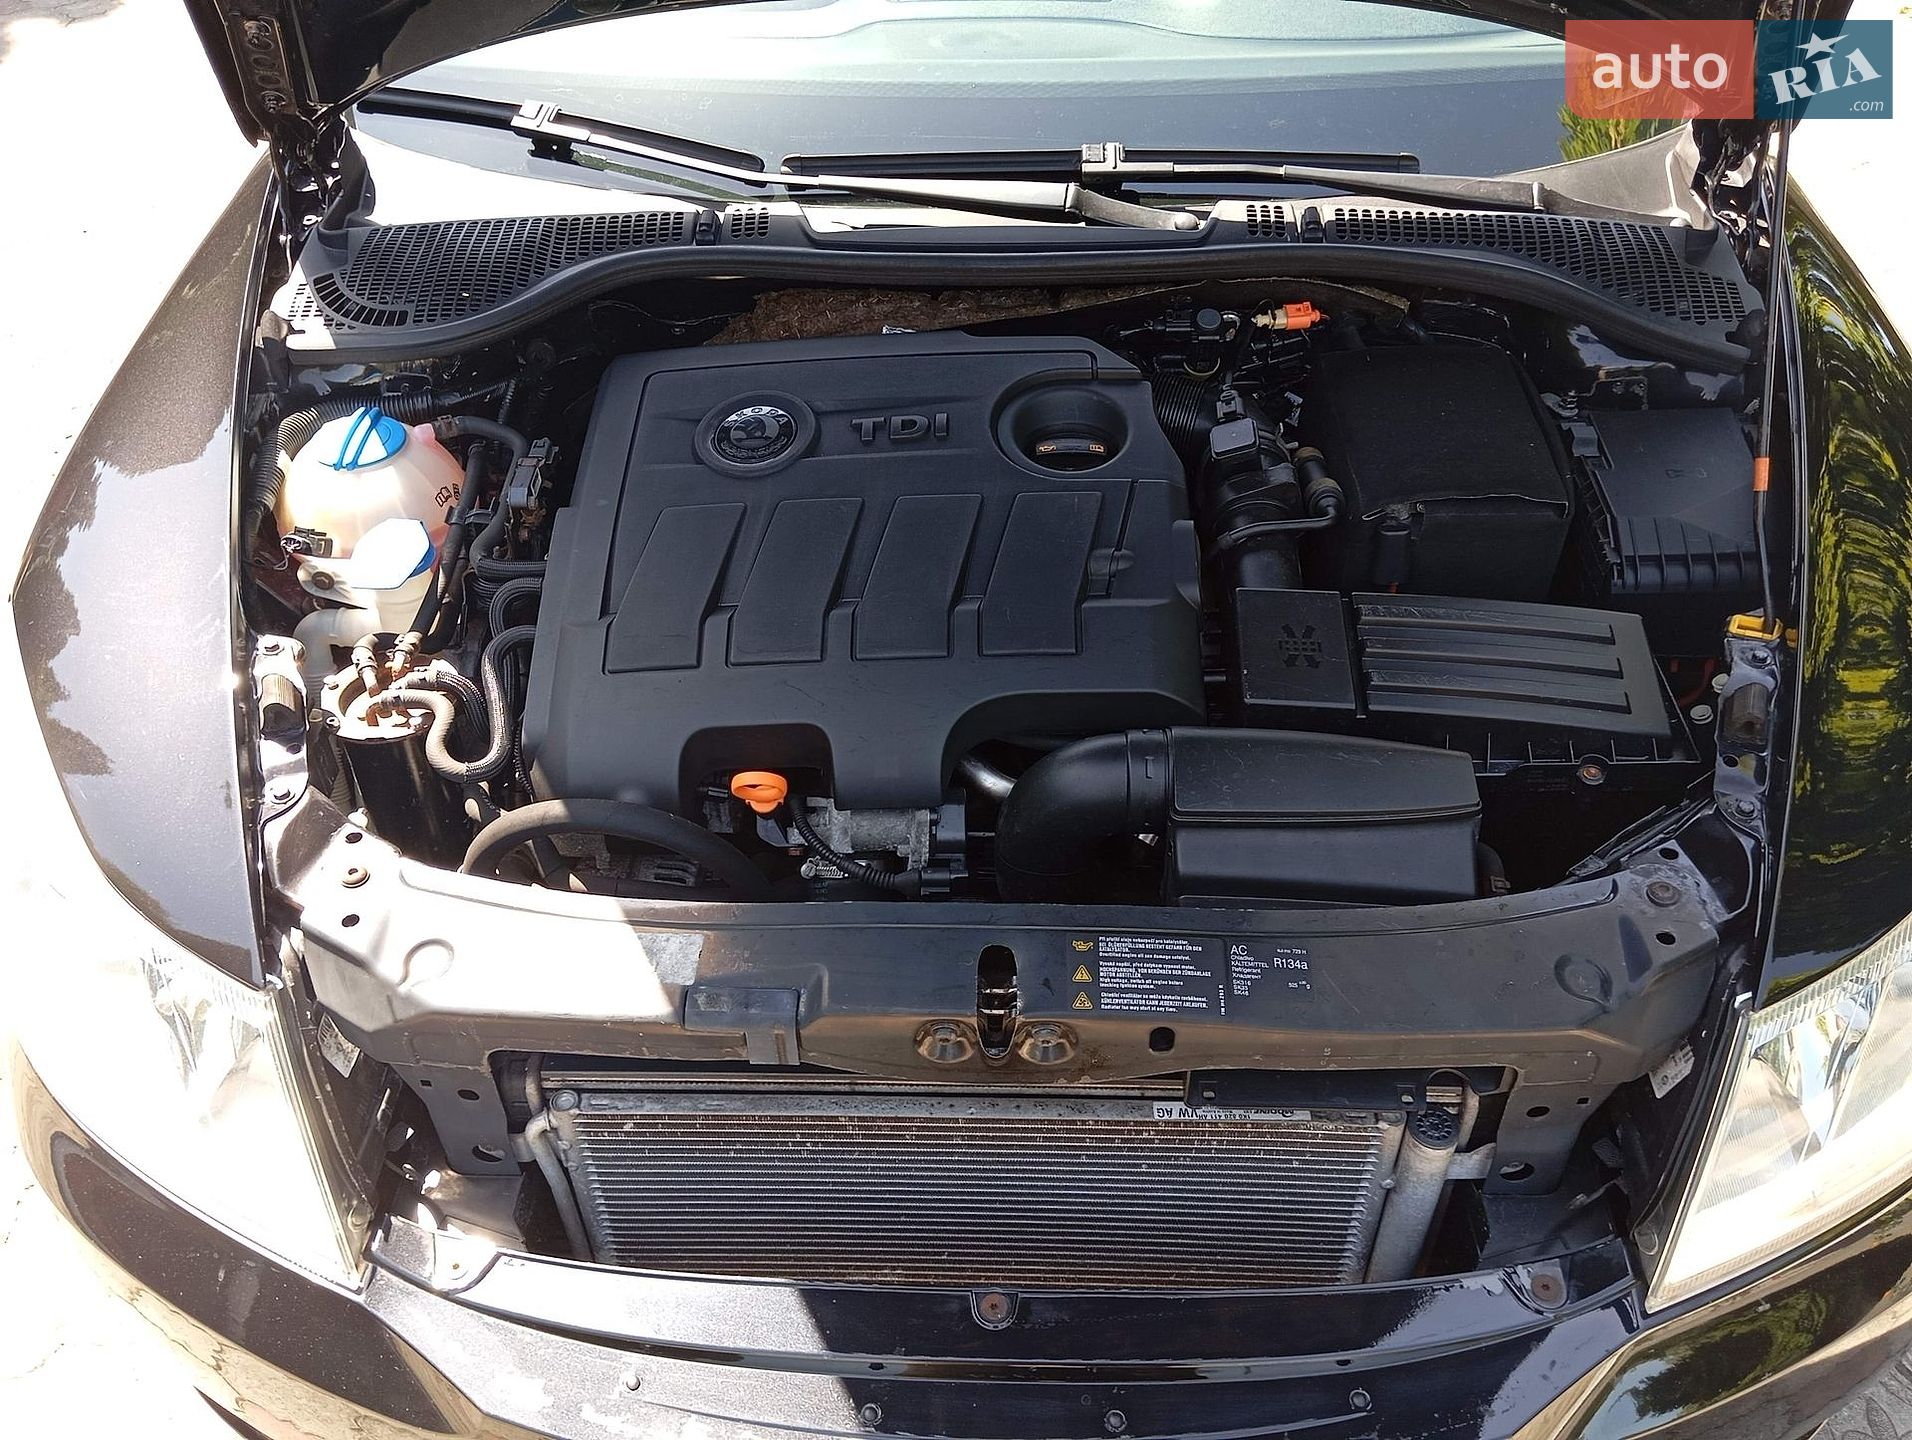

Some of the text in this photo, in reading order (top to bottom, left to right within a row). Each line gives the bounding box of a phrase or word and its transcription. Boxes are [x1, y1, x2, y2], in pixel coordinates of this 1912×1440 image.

[851, 412, 948, 441] TDI
[1230, 944, 1248, 955] AC
[1274, 958, 1308, 970] R134a
[1156, 1108, 1199, 1118] VW AG
